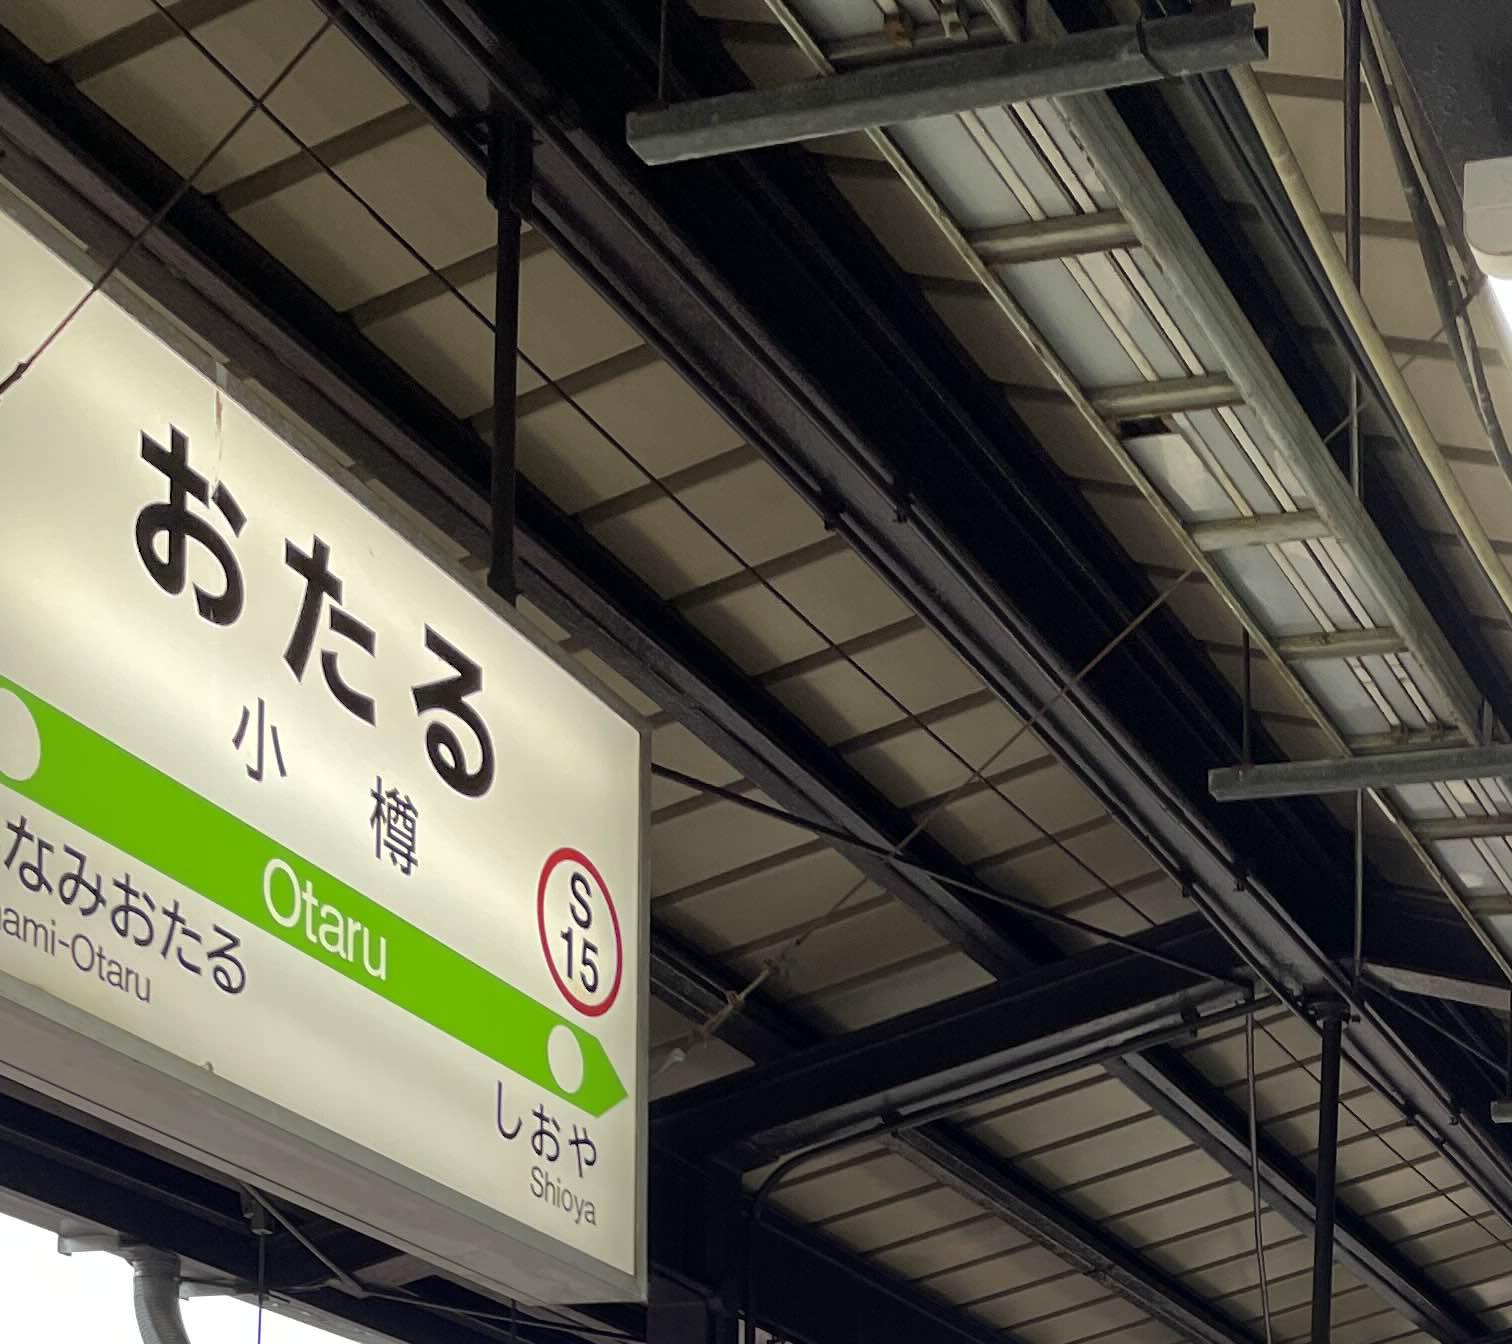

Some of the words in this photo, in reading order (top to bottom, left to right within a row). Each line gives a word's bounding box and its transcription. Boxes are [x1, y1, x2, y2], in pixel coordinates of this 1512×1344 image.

[134, 424, 496, 799] おたる
[232, 696, 419, 876] 小樽
[4, 815, 246, 995] なみおたる
[262, 857, 388, 983] Otaru
[568, 873, 593, 930] S
[0, 906, 152, 1003] ami-Otaru
[559, 927, 600, 995] 15
[495, 1079, 599, 1180] しおや
[529, 1165, 597, 1228] Shioya
